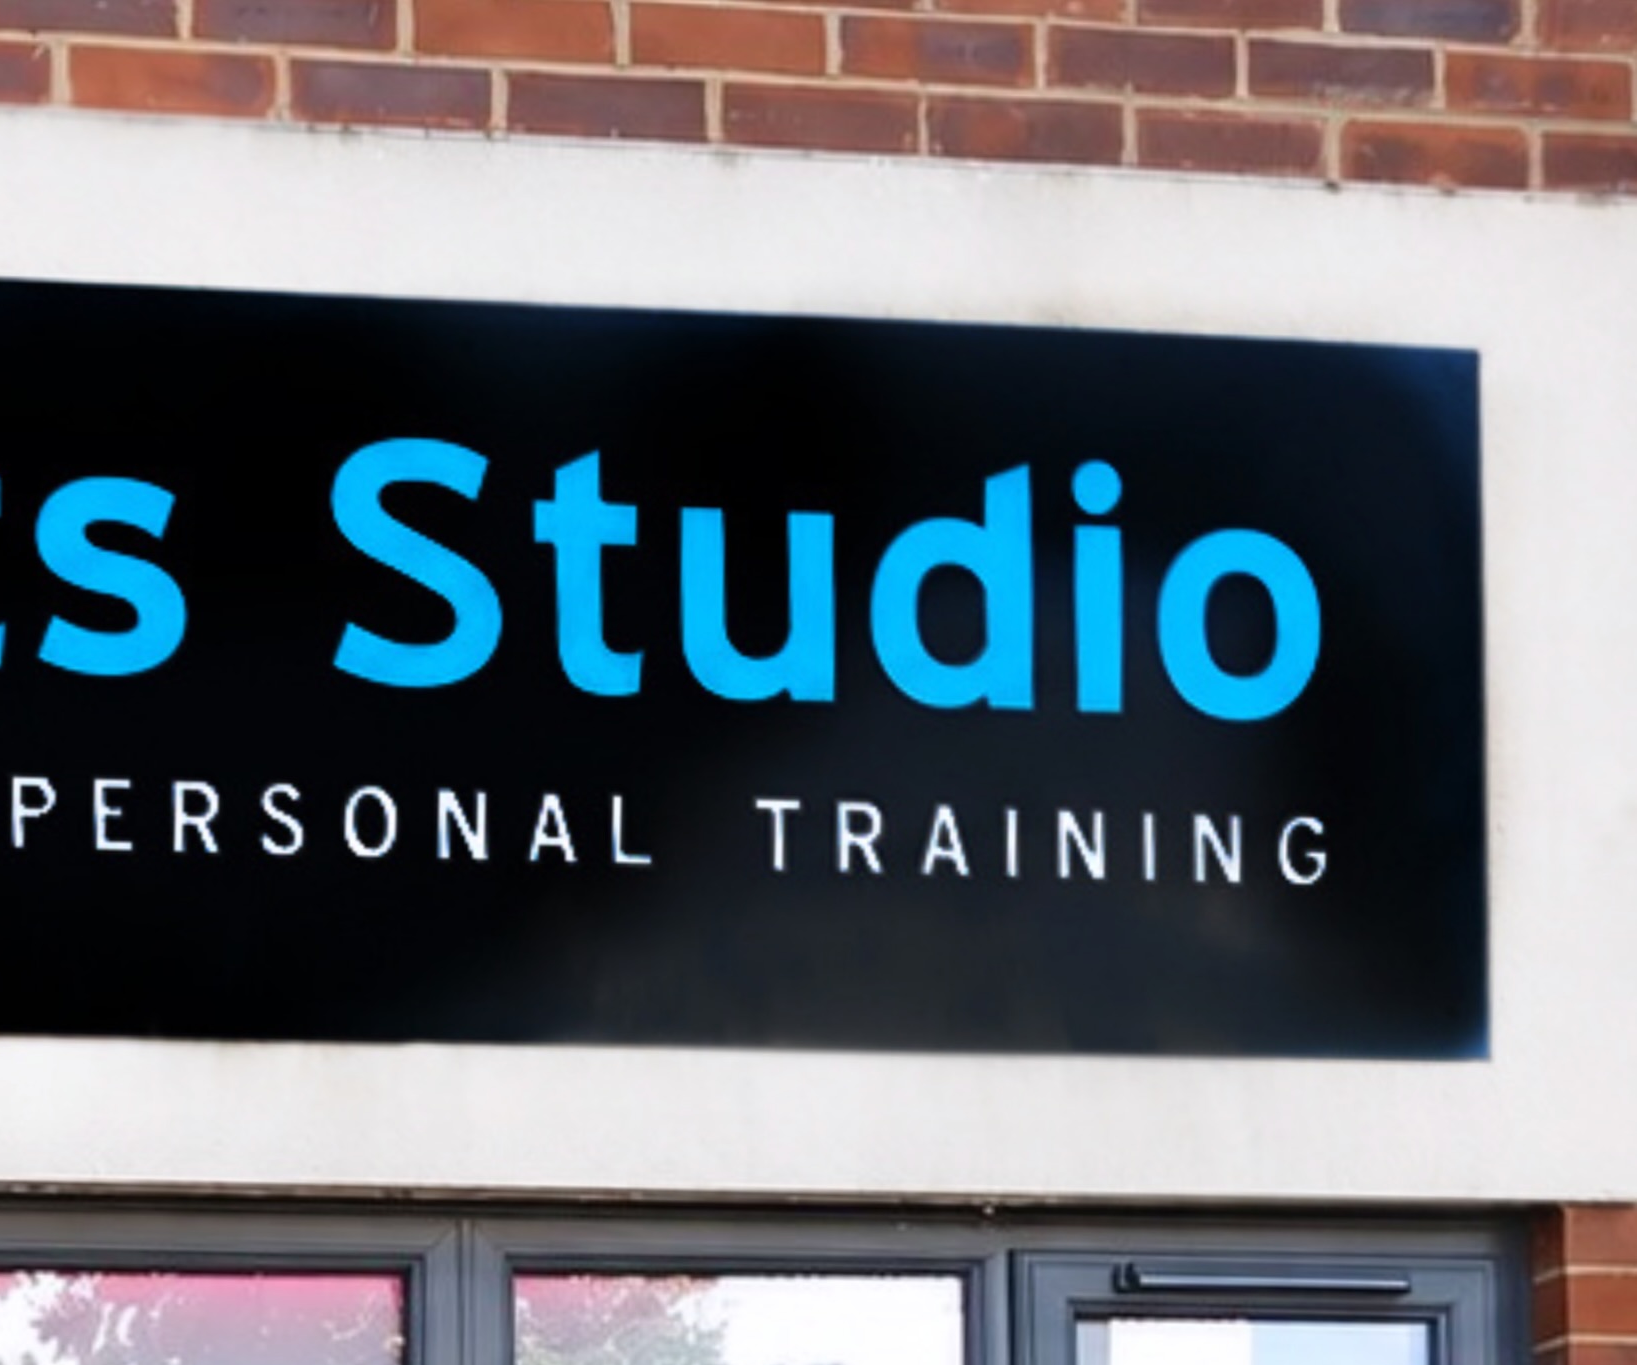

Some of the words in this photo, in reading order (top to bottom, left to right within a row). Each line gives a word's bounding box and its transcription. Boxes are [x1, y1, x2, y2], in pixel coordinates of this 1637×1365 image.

[331, 438, 1321, 721] Studio
[12, 777, 651, 864] PERSONAL
[756, 799, 1326, 884] TRAINING
